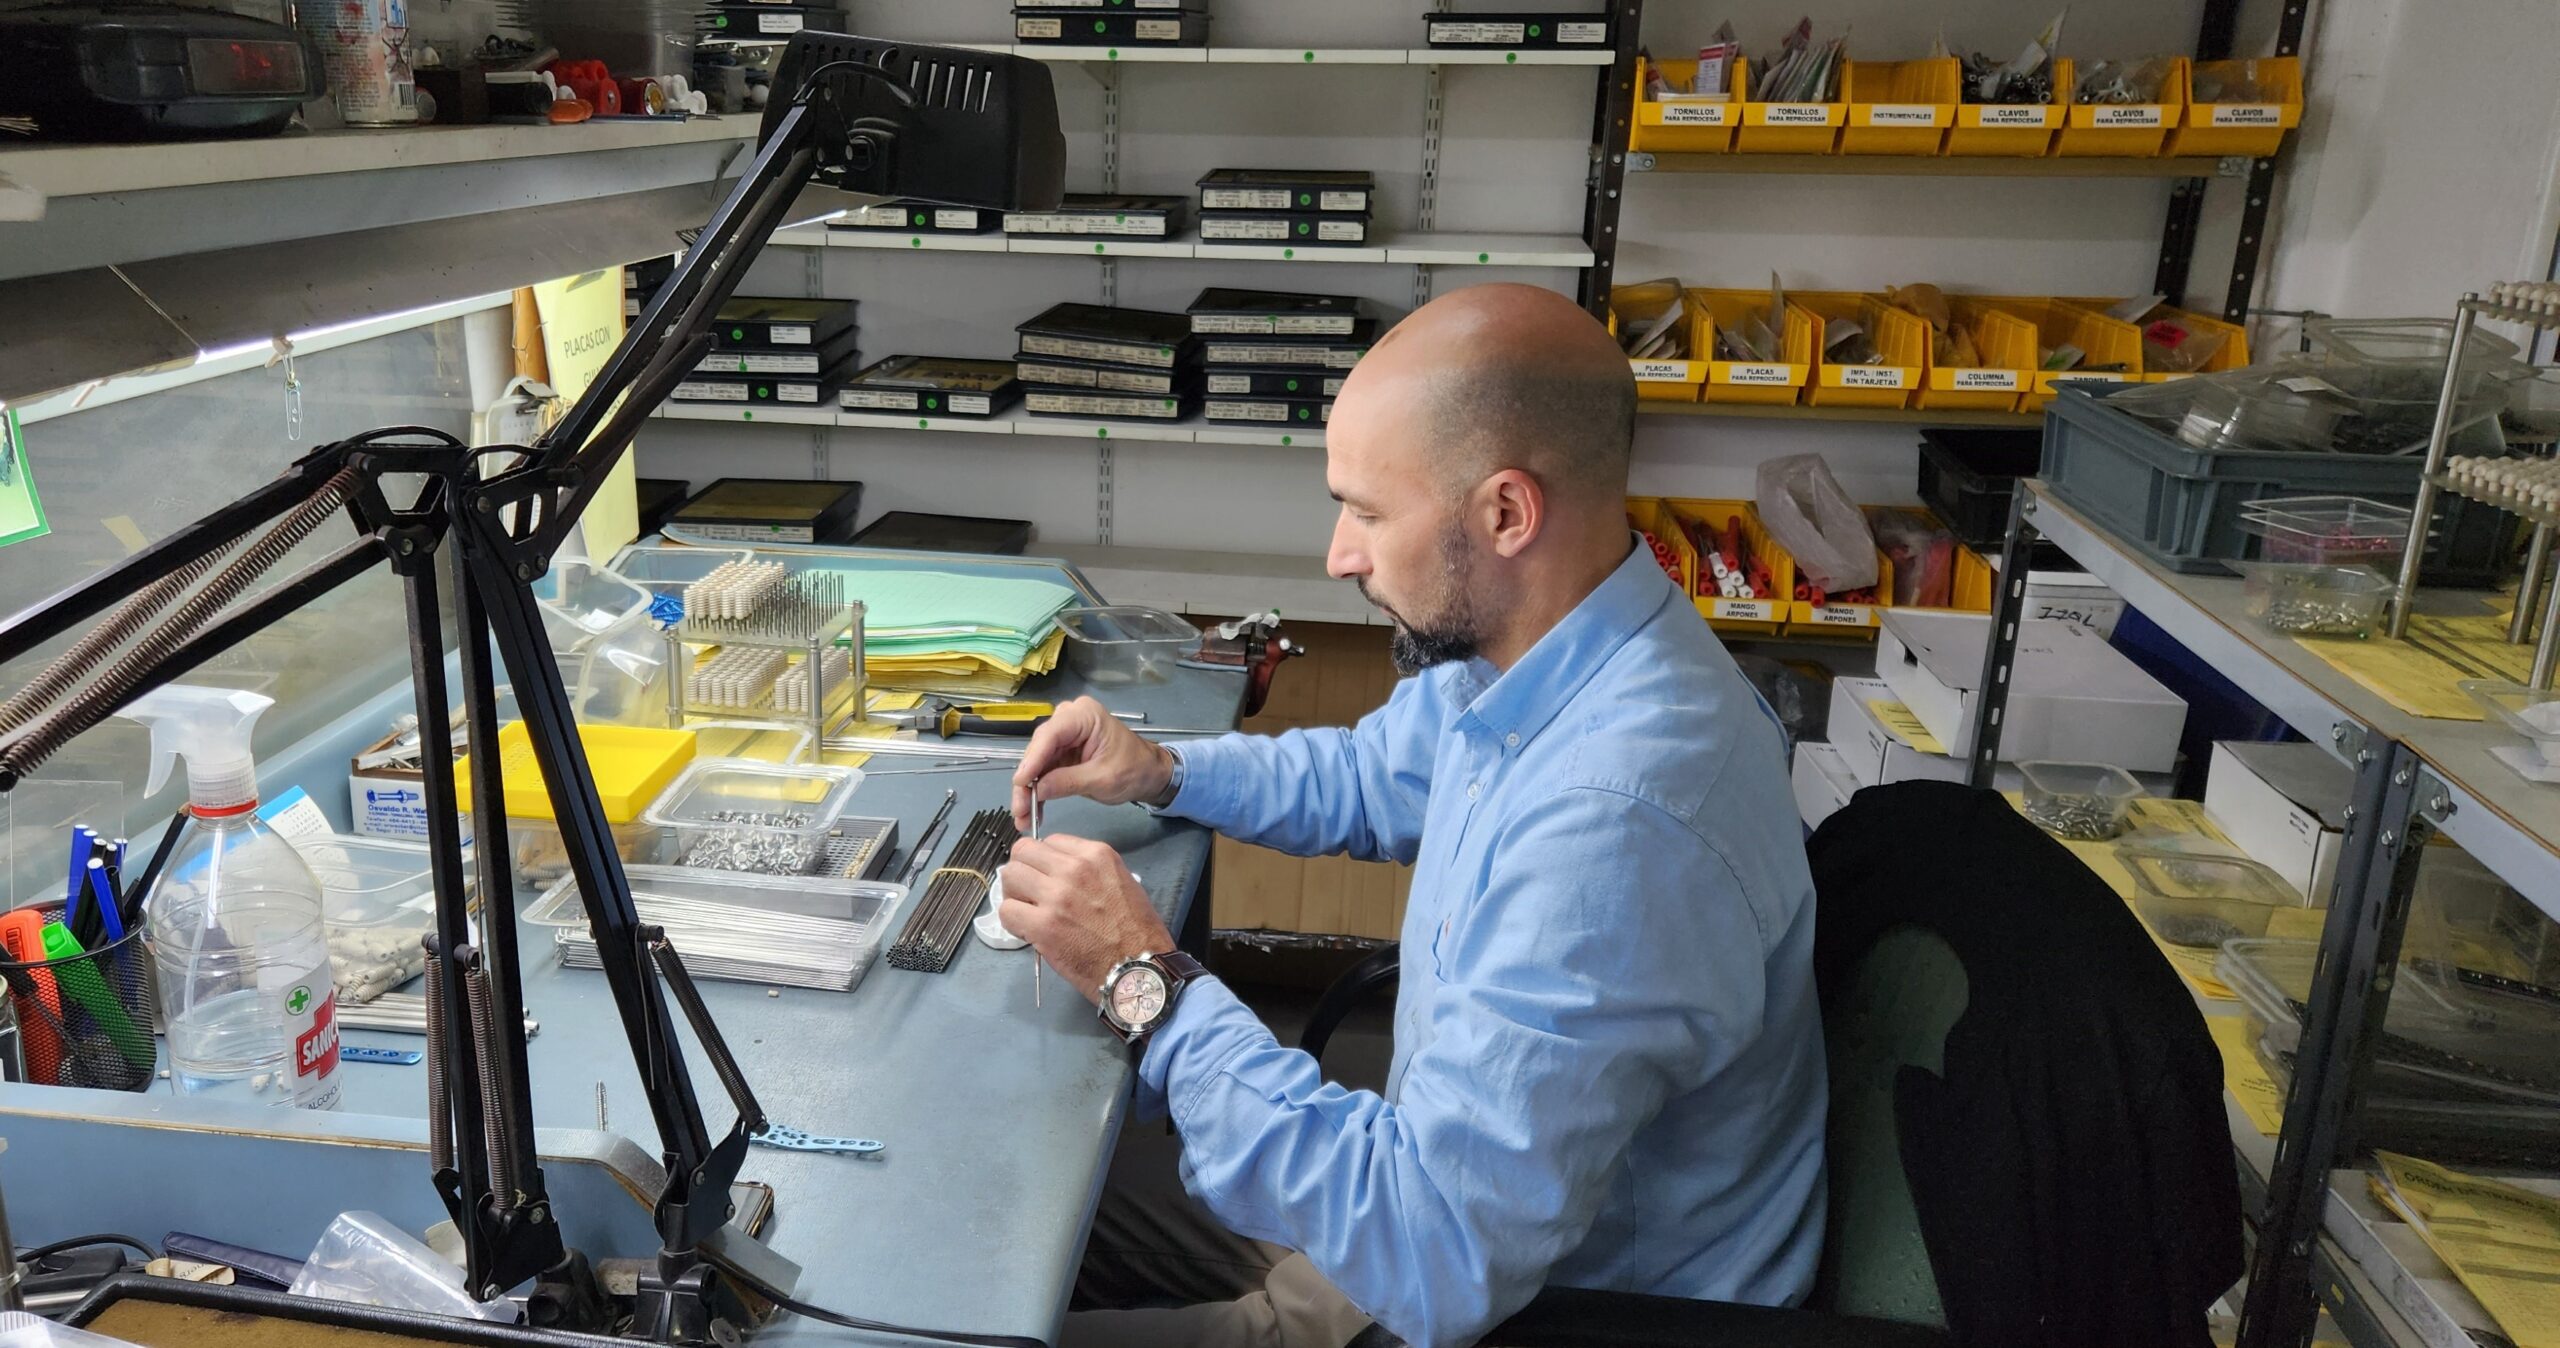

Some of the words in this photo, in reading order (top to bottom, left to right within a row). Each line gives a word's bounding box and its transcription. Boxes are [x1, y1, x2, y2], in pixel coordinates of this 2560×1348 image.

[1673, 108, 1715, 116] TORNILLOS
[1777, 108, 1819, 116] TORNILLOS
[1873, 112, 1932, 120] INSTRUMENTALES
[1998, 109, 2029, 117] CLAVOS
[2112, 109, 2145, 117] CLAVOS
[564, 331, 595, 359] PLACAS
[595, 325, 611, 346] CON
[1730, 602, 1756, 610] MANGO
[1726, 610, 1759, 618] ARPONES
[1828, 607, 1854, 615] MANGO
[1824, 615, 1857, 623] ARPONES
[368, 804, 401, 813] Osvaldo
